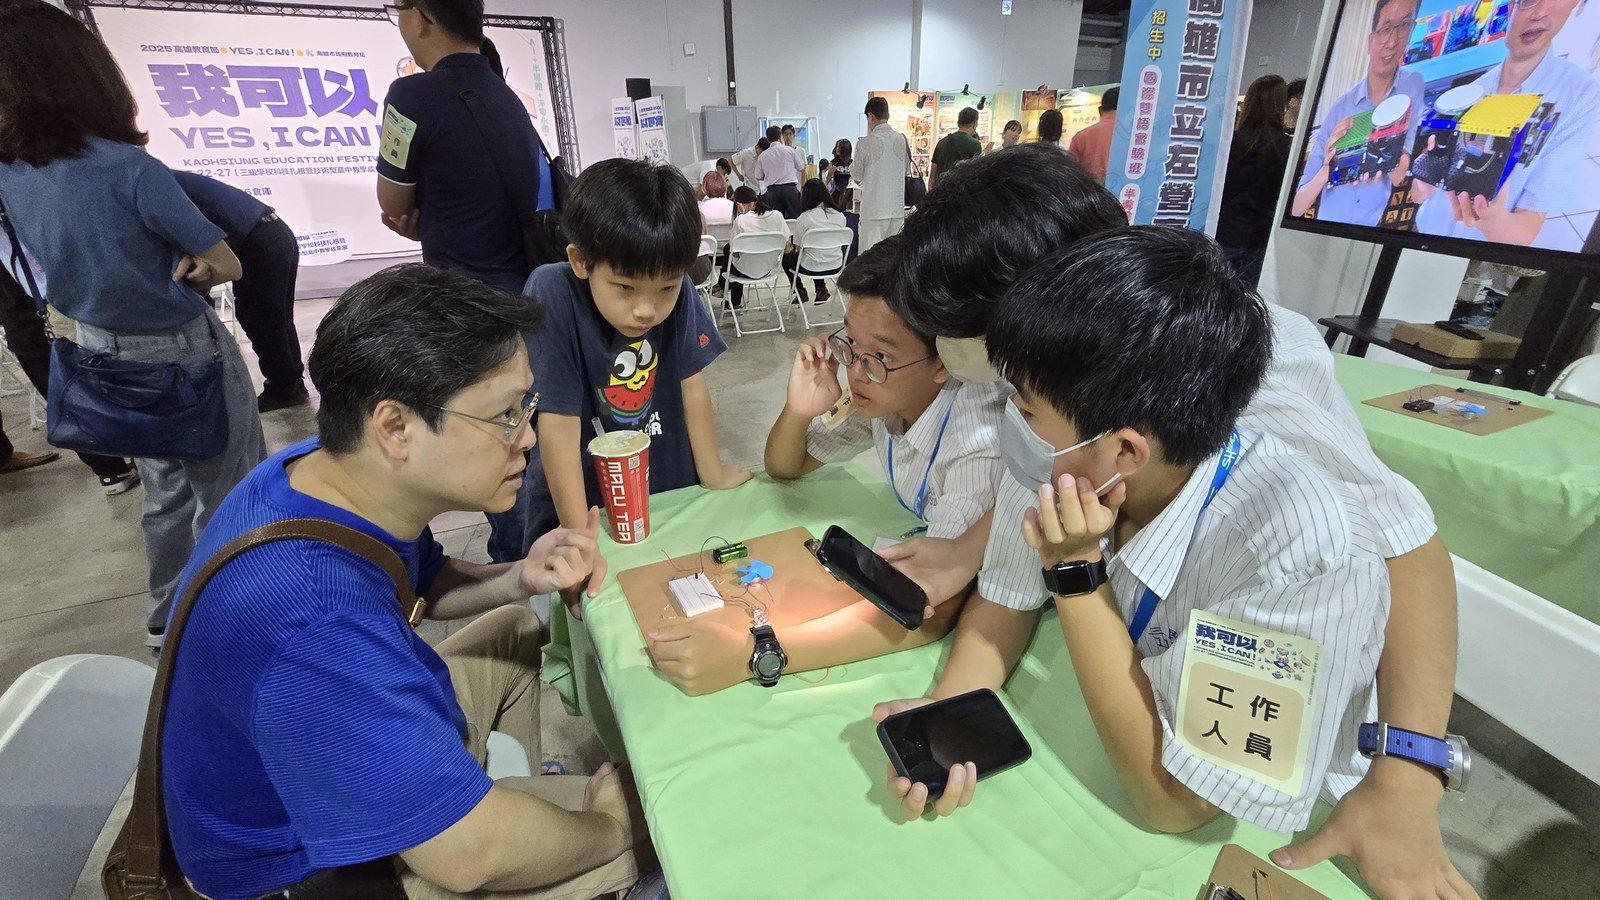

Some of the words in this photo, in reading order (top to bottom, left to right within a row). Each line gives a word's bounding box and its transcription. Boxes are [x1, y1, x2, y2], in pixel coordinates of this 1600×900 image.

[1147, 9, 1166, 60] 招生中
[147, 64, 378, 118] 我可以
[183, 158, 260, 166] KAOHSIUNG
[263, 156, 334, 165] EDUCATION
[607, 461, 627, 507] MACU
[616, 512, 632, 543] TEA
[1195, 622, 1258, 652] 我可以
